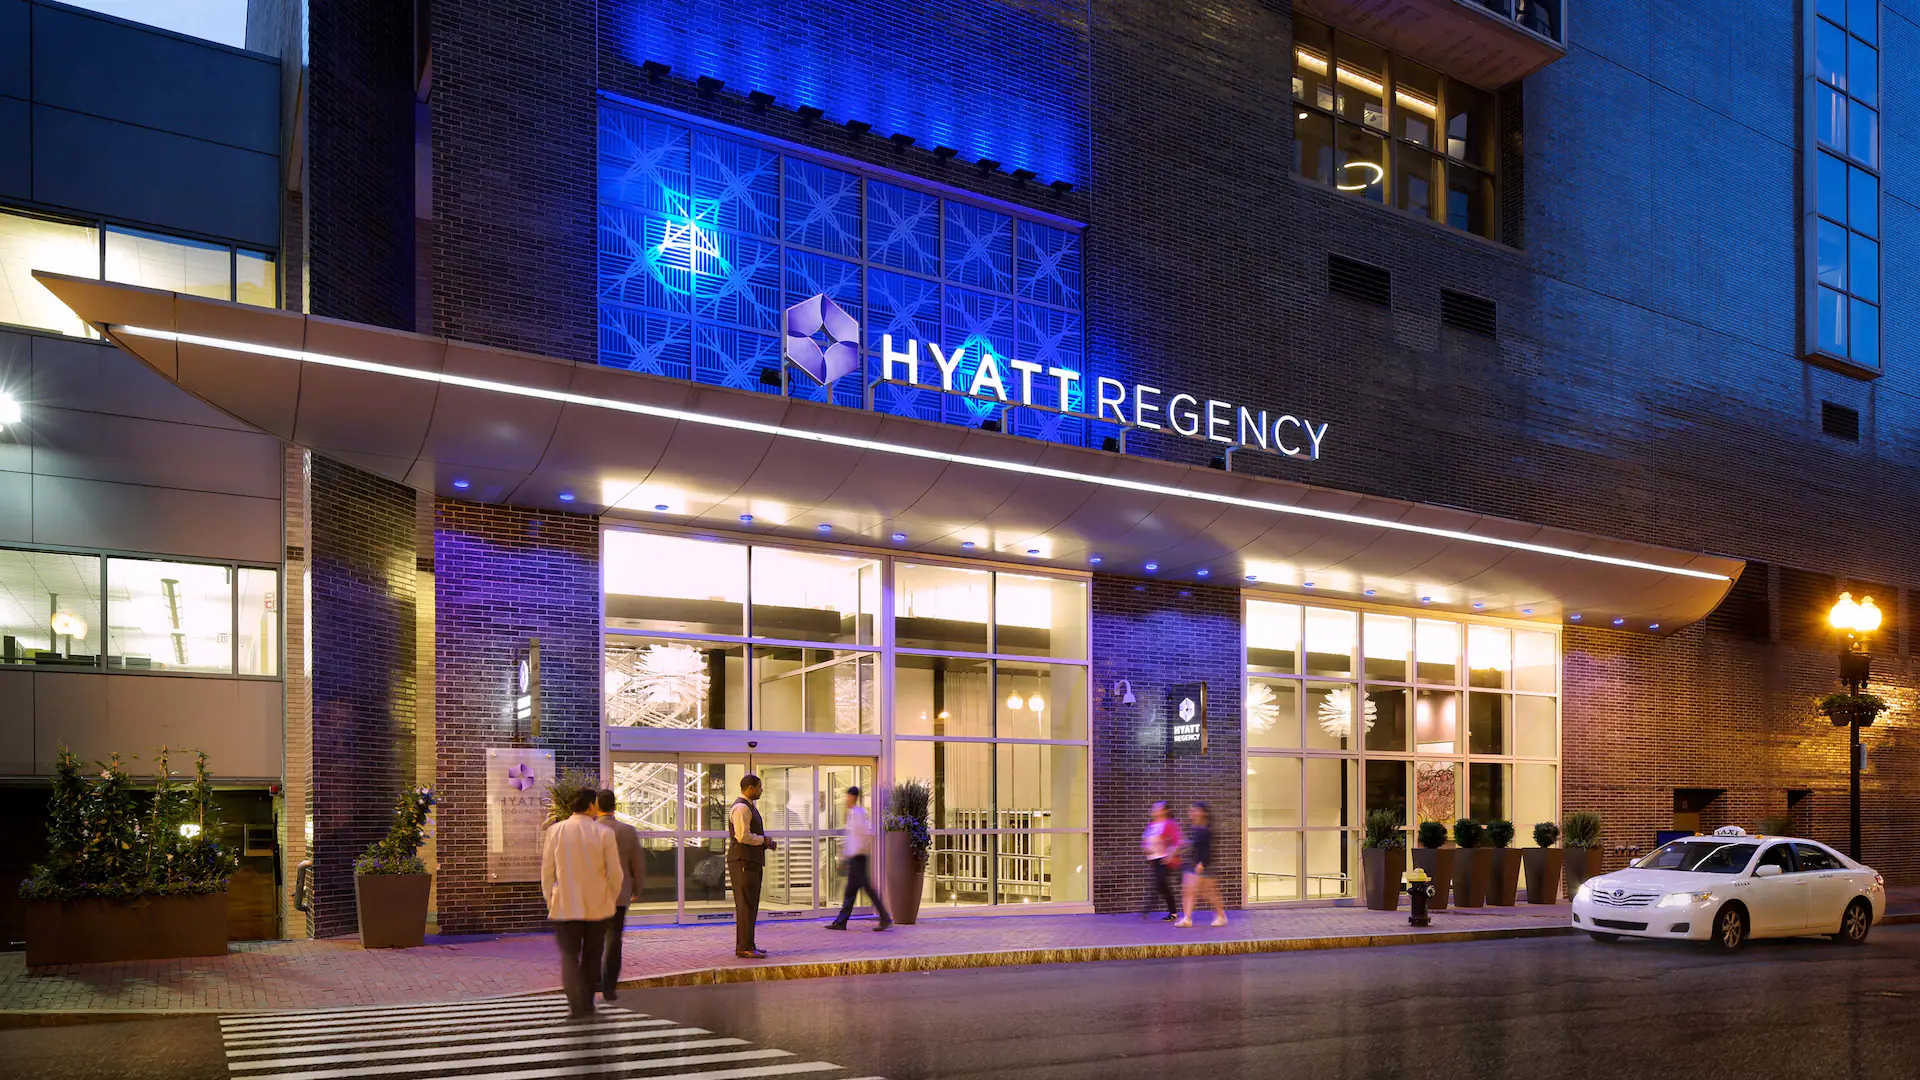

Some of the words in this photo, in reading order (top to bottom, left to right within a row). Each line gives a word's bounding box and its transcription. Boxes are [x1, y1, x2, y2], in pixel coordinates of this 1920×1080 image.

[882, 333, 1080, 413] HYATT
[1097, 376, 1329, 460] REGENCY
[1174, 724, 1200, 735] HYATT
[1174, 733, 1200, 742] REGENCY
[498, 796, 546, 806] HYATT
